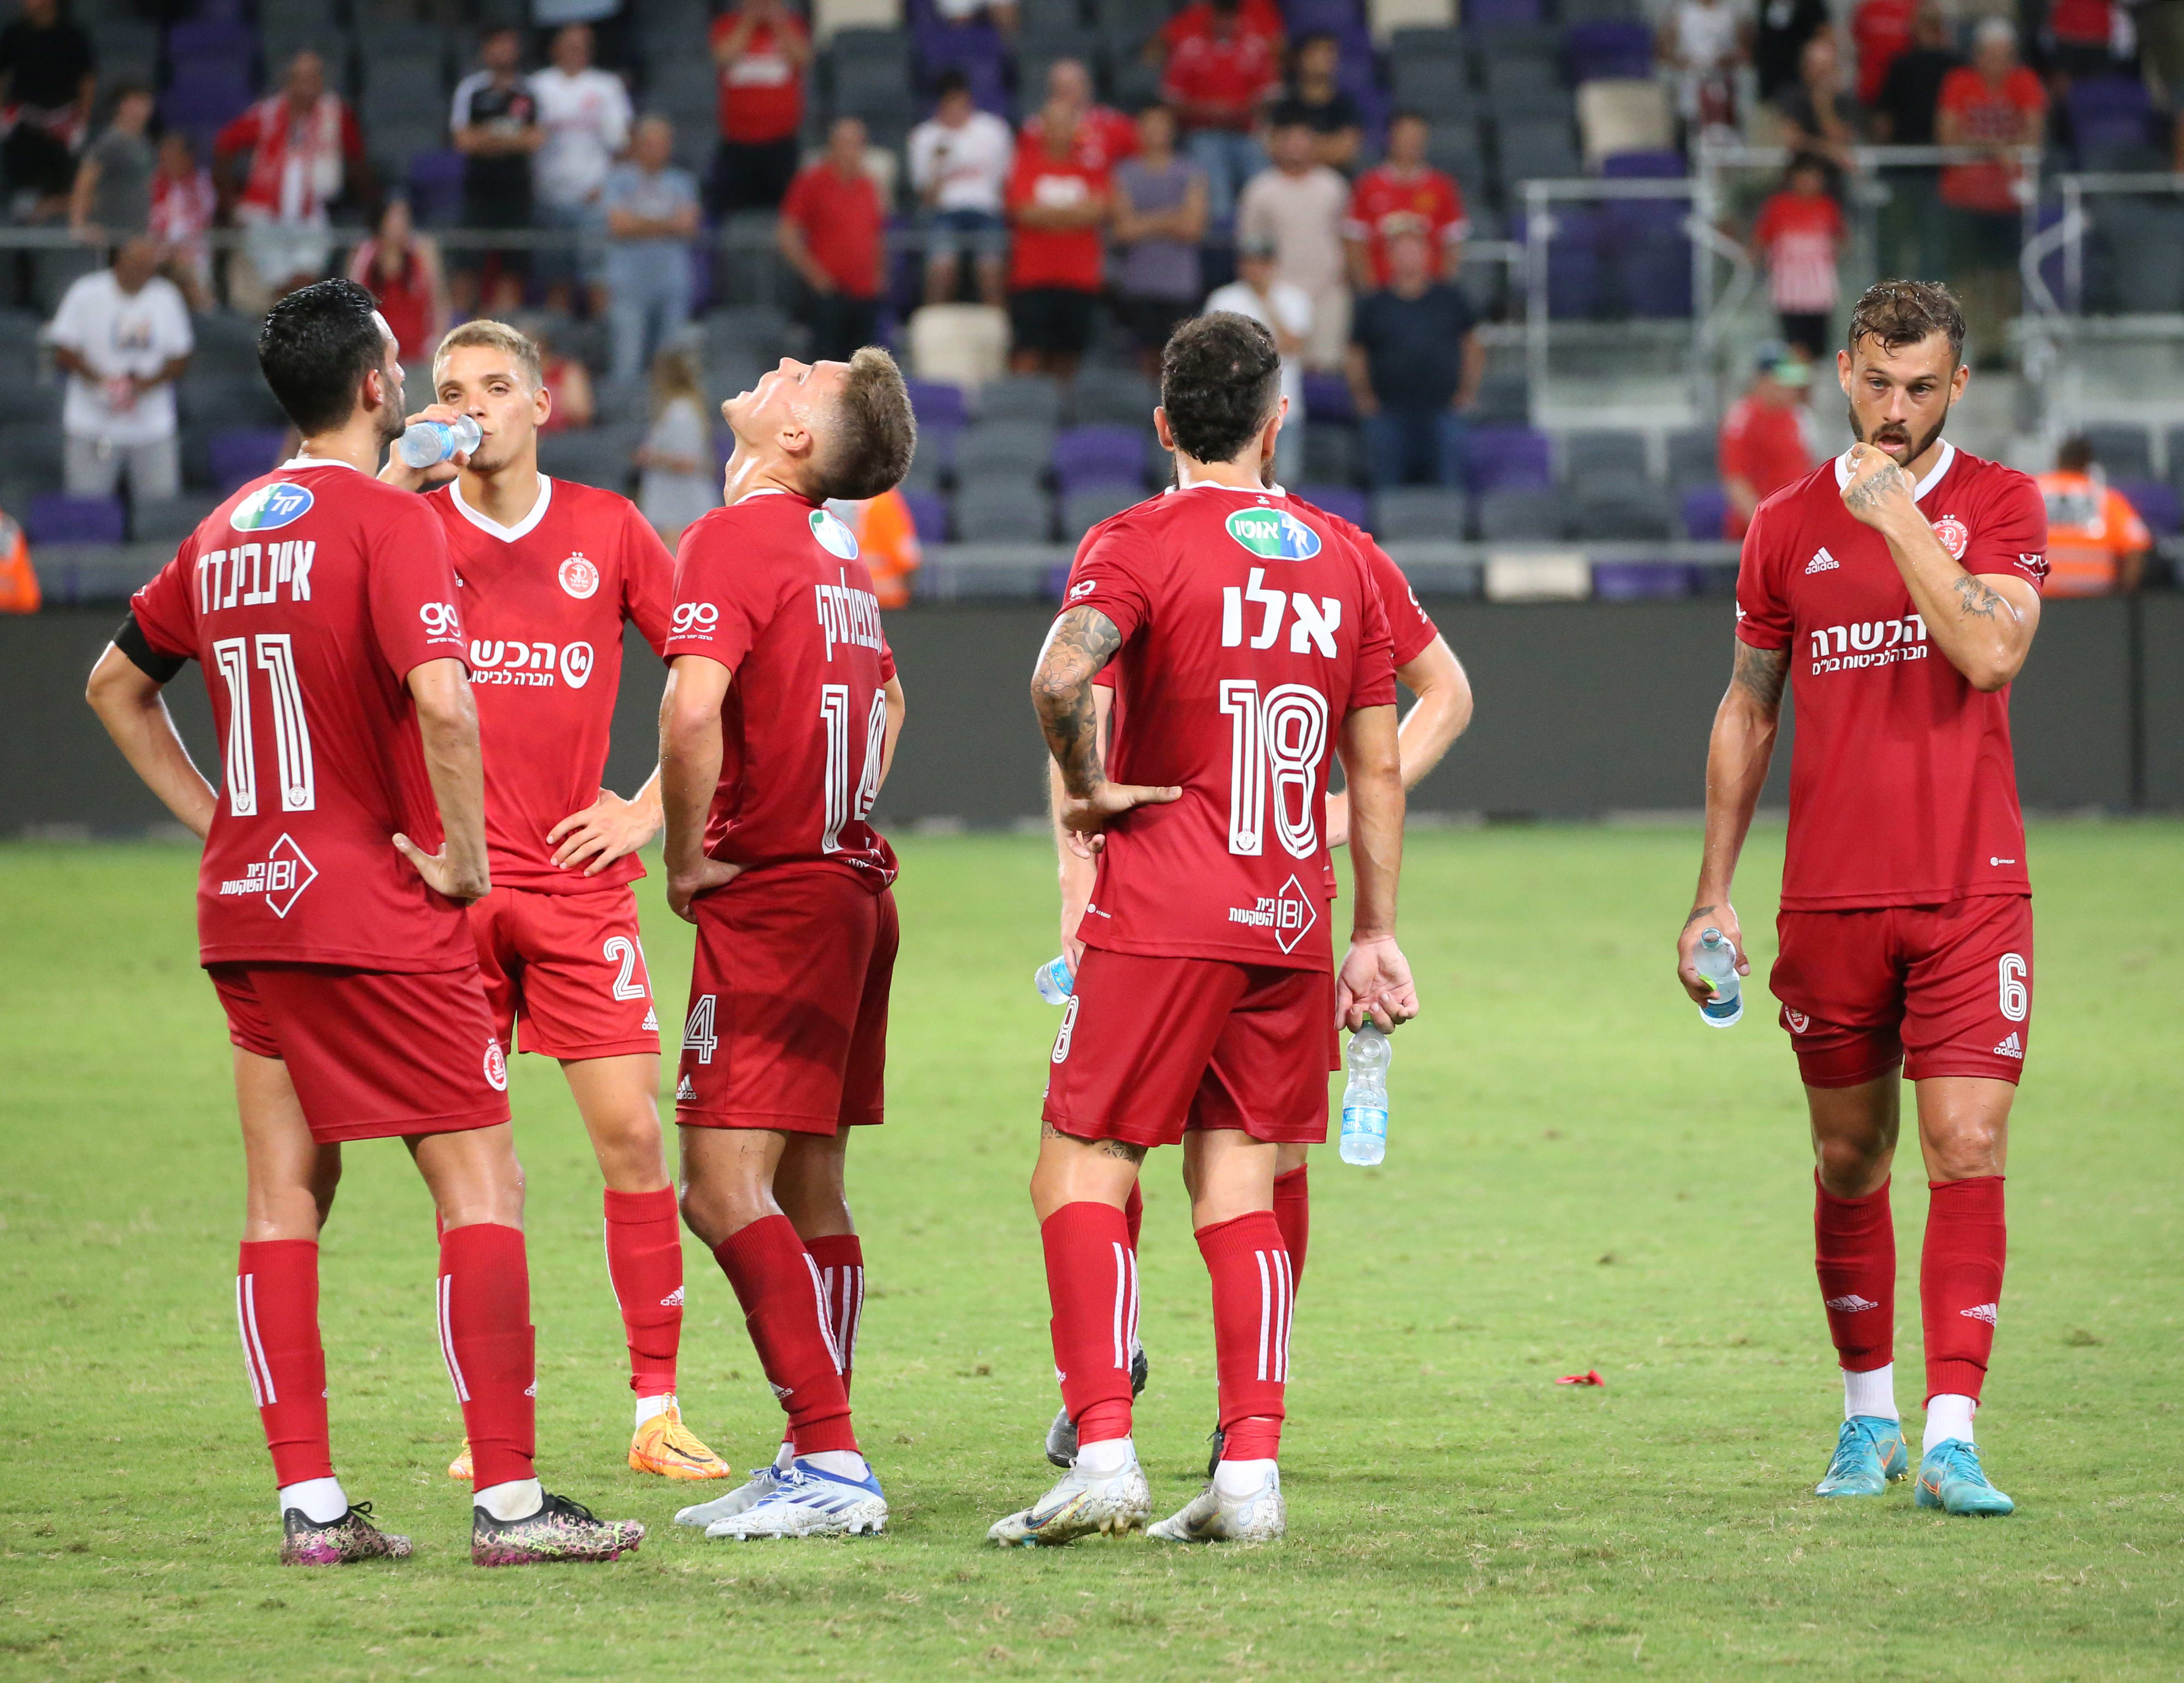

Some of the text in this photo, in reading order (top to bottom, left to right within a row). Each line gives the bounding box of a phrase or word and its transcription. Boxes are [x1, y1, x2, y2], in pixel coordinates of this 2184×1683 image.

[1234, 519, 1280, 539] אוטו
[198, 540, 316, 615] איינבינדר
[1805, 560, 1840, 575] adidas
[419, 602, 459, 635] go
[672, 602, 719, 633] go
[1221, 567, 1342, 659] אלו
[1811, 614, 1927, 658] הכשרה
[470, 639, 556, 669] הכש
[1843, 649, 1890, 670] לביטוח
[1891, 645, 1927, 662] חברה
[468, 669, 554, 687] חברה לביטו
[213, 634, 315, 816] 11
[820, 683, 887, 854] 14
[1219, 679, 1329, 860] 18
[247, 862, 266, 878] בית
[266, 859, 298, 891] IBI
[219, 877, 265, 896] השקעות
[1228, 907, 1274, 927] השקעות
[1255, 897, 1275, 912] בית
[1276, 899, 1303, 929] IBI
[1998, 953, 2028, 1022] 6
[679, 994, 719, 1064] 4
[1993, 1046, 2023, 1060] adidas
[1960, 1309, 1997, 1328] adida
